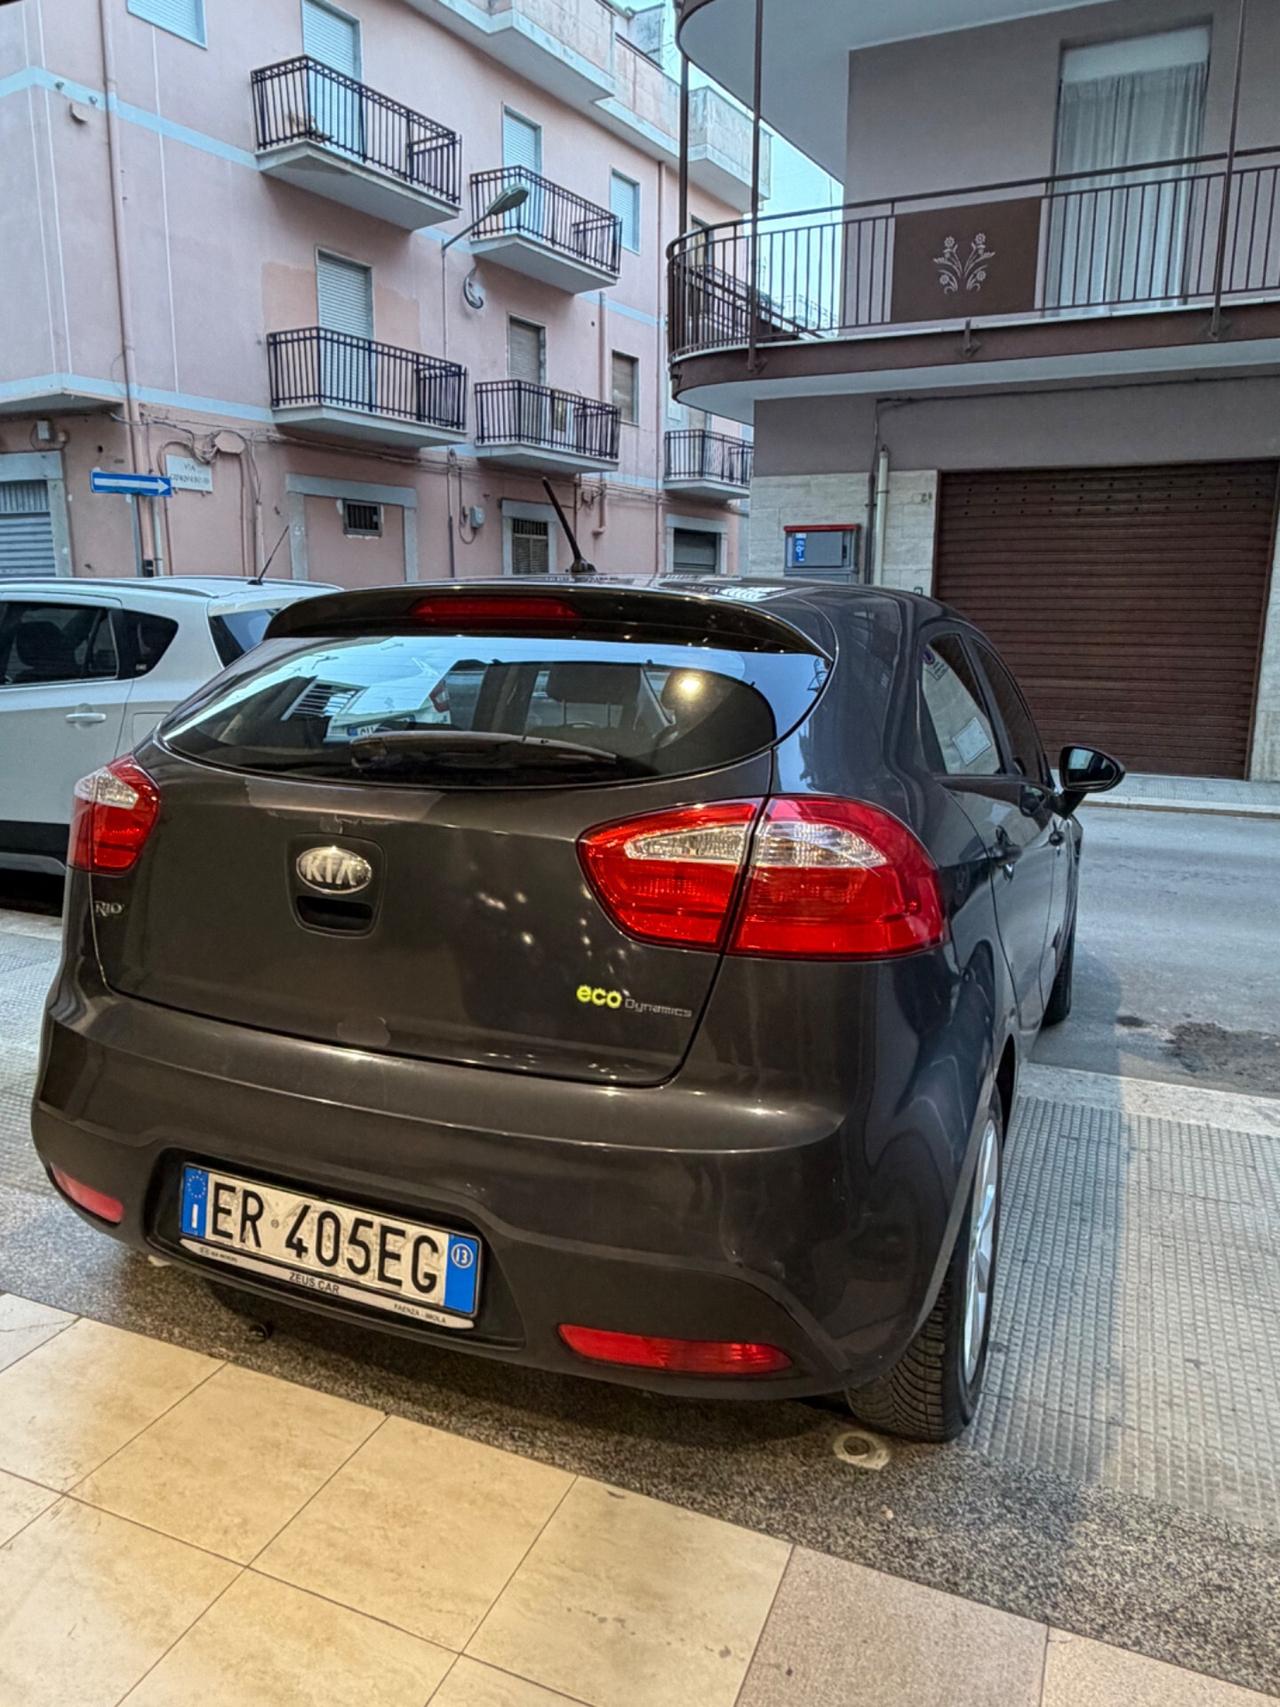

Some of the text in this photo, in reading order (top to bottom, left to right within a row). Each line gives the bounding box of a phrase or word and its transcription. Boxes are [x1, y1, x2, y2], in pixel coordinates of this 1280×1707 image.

[305, 855, 357, 885] KIA
[95, 900, 123, 917] RIO
[576, 985, 692, 1017] eco Dynamics
[191, 1182, 440, 1294] I ER 405EG
[289, 1272, 340, 1295] ZEUS CAR
